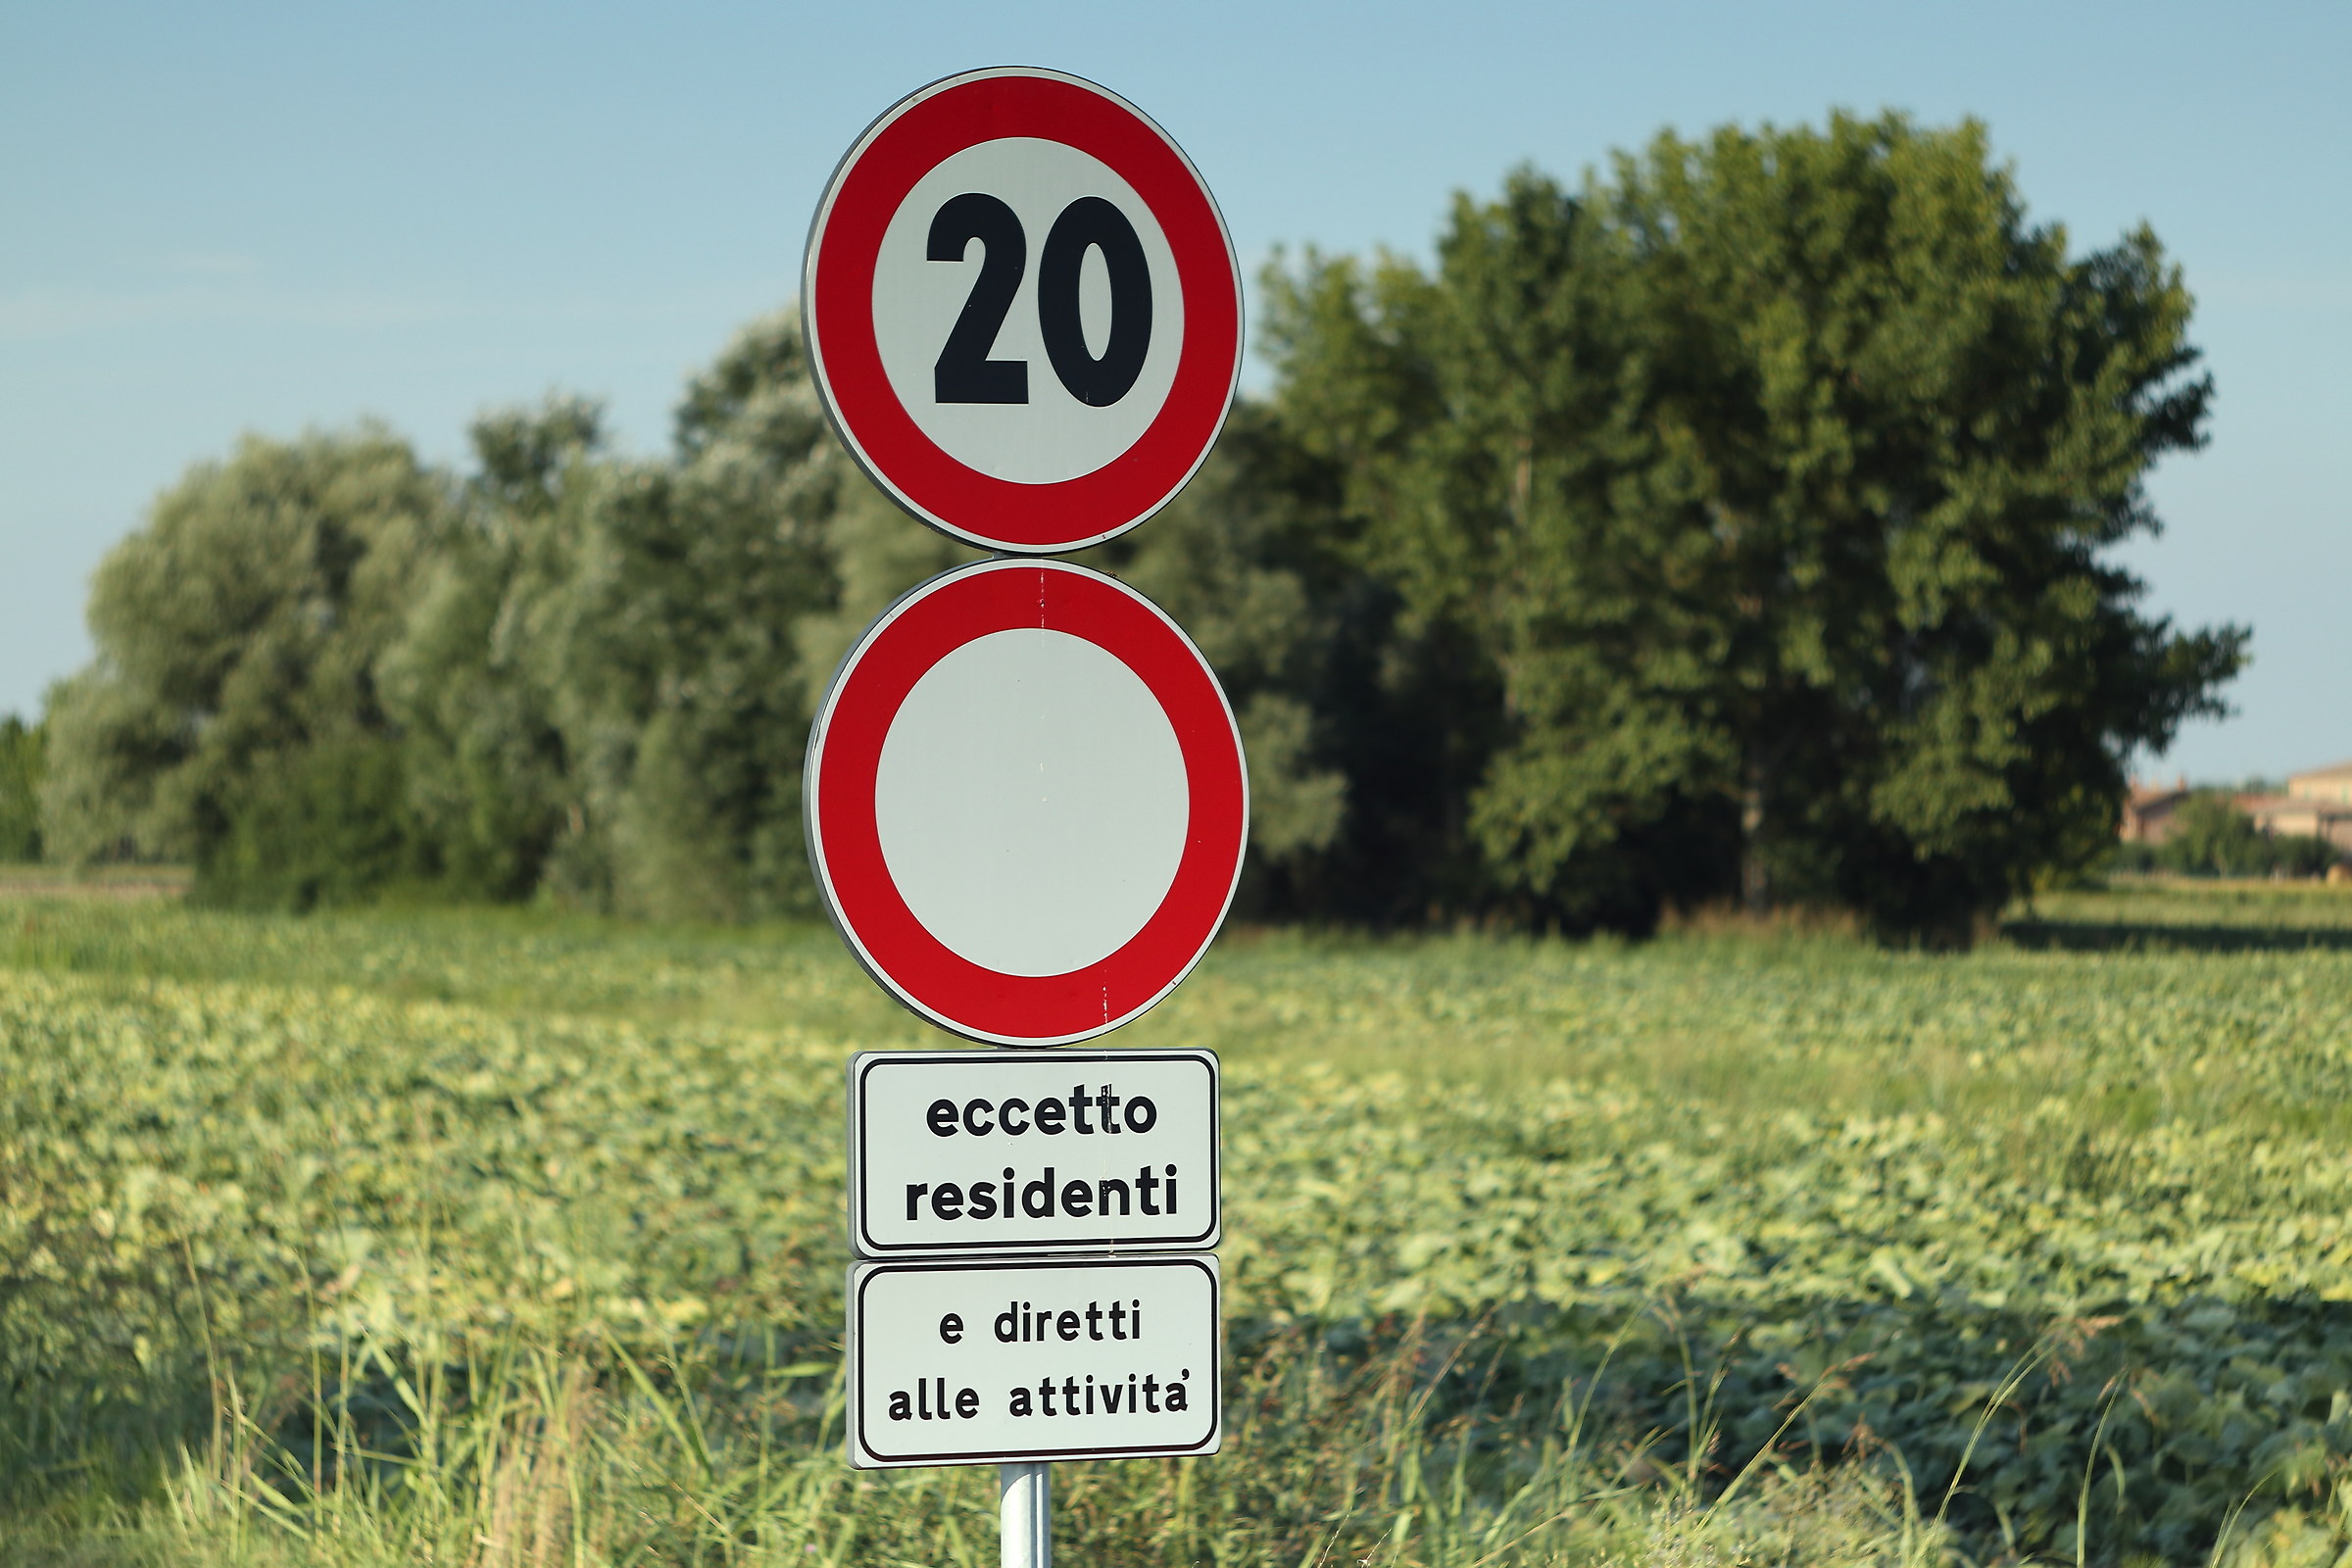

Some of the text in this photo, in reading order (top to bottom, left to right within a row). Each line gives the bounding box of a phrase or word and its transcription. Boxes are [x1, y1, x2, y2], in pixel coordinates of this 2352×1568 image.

[926, 192, 1153, 408] 20
[926, 1083, 1157, 1138] eccetto
[906, 1163, 1178, 1221] residenti
[939, 1298, 1141, 1345] e diretti
[888, 1377, 980, 1421] alle
